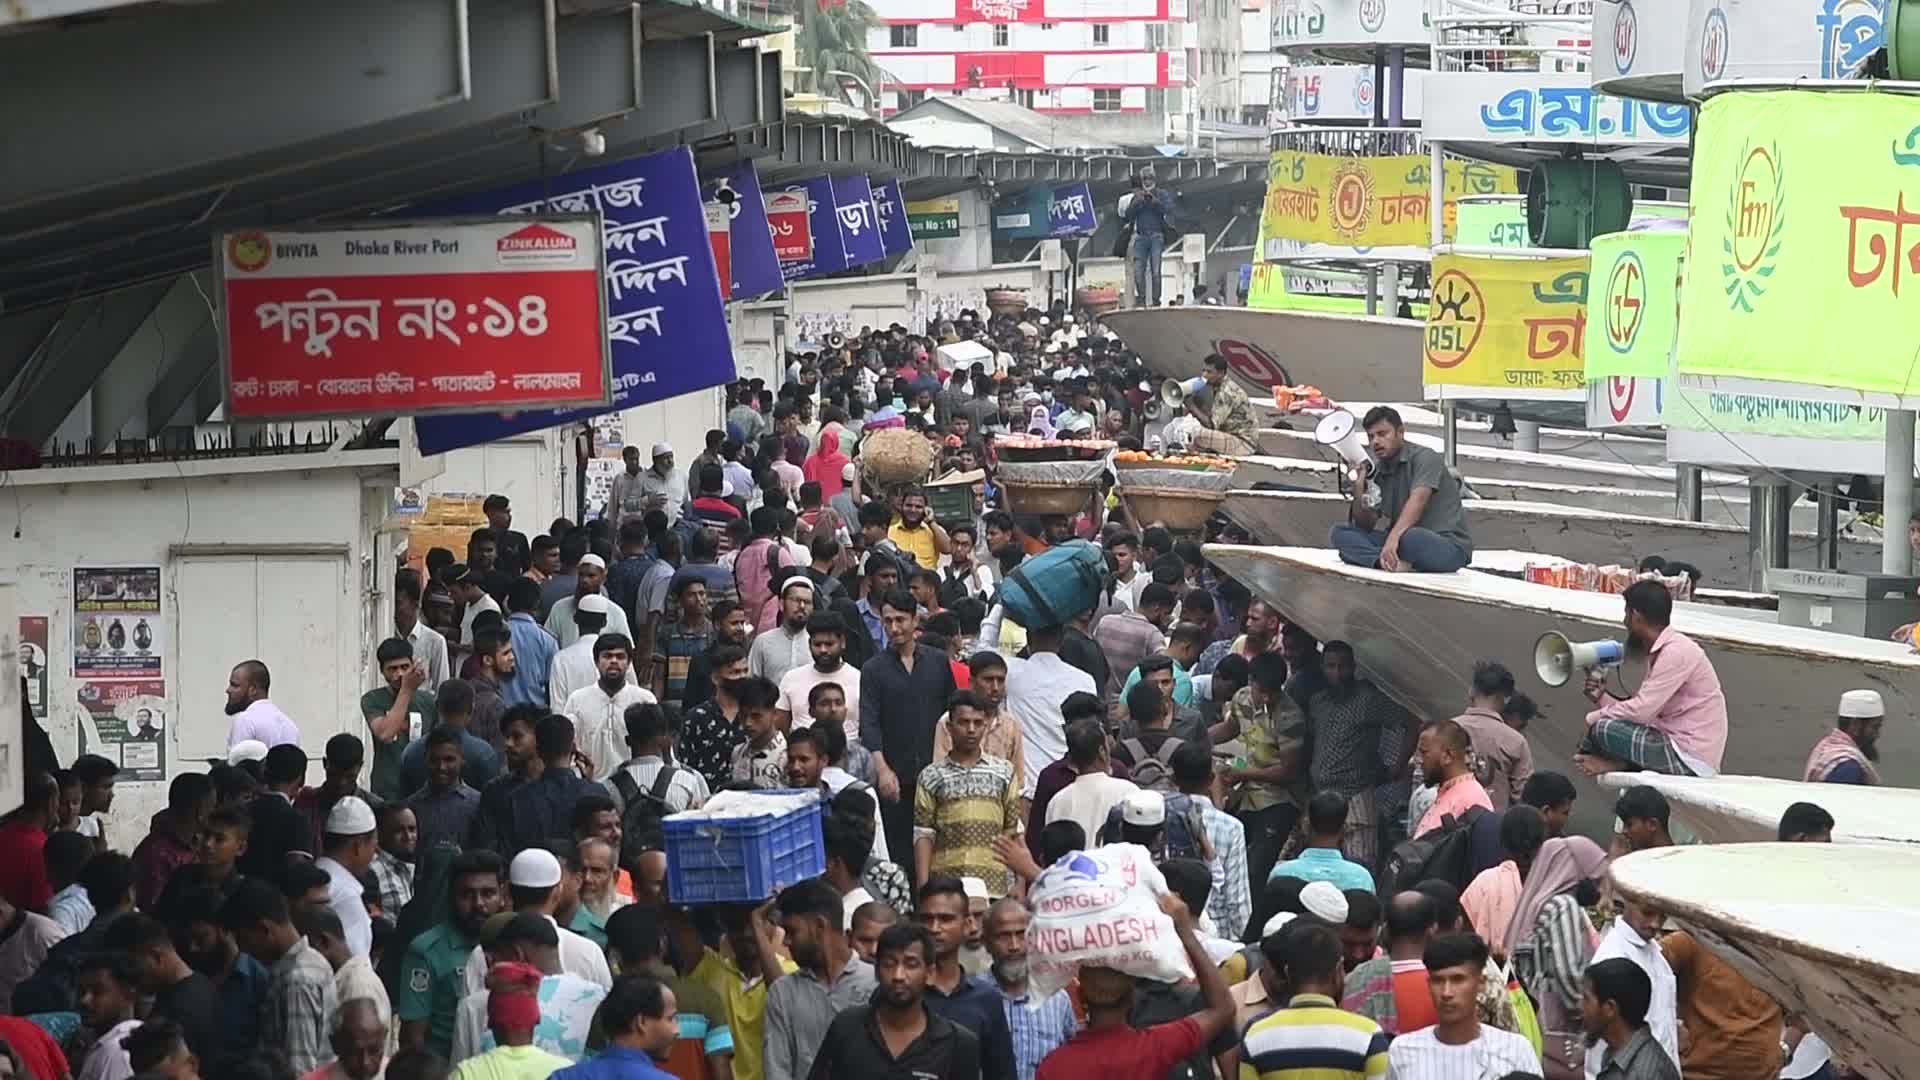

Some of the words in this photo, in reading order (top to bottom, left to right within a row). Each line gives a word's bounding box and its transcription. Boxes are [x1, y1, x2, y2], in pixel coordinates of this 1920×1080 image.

[276, 243, 318, 258] BIWTA
[345, 240, 389, 256] Dhaka
[394, 239, 427, 255] River
[432, 237, 458, 254] Port
[502, 238, 572, 249] ZINKALUM
[256, 288, 381, 358] পন্টুন
[1429, 325, 1465, 351] ASL
[1041, 893, 1114, 914] MORGEN
